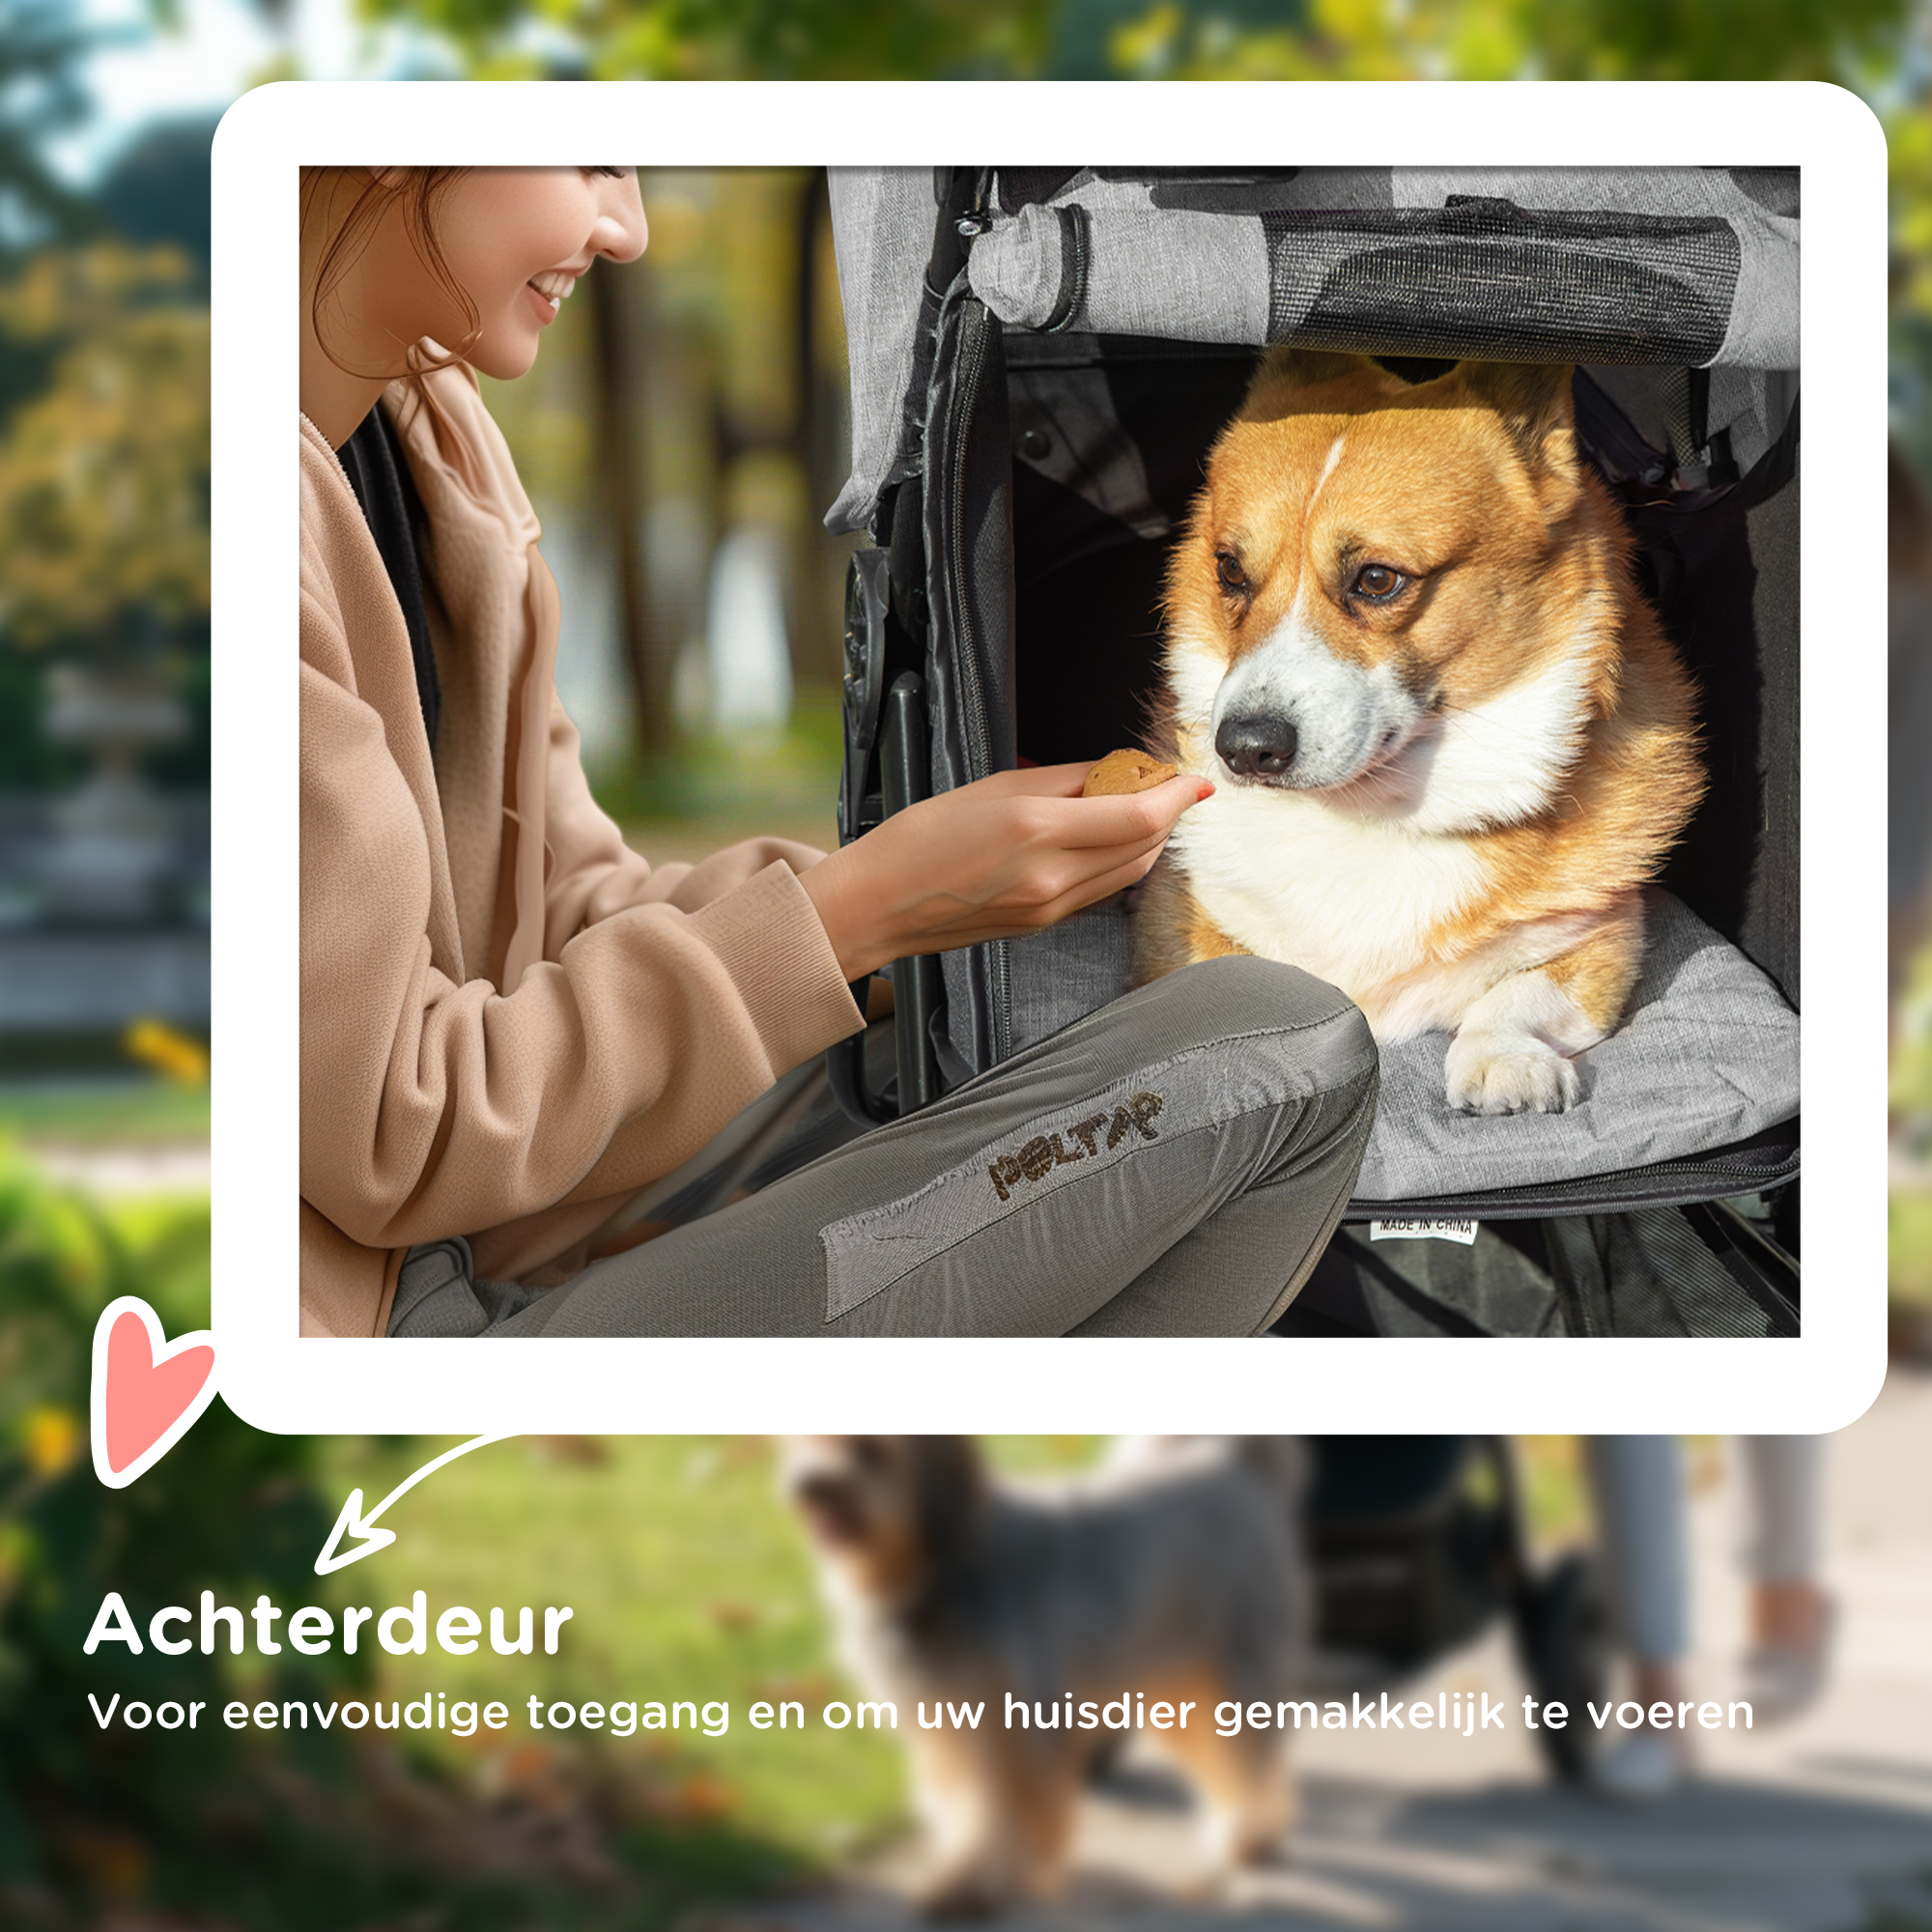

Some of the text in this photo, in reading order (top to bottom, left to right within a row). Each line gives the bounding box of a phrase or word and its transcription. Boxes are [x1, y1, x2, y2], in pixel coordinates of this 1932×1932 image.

[1379, 1217, 1472, 1235] MADE IN CHINA
